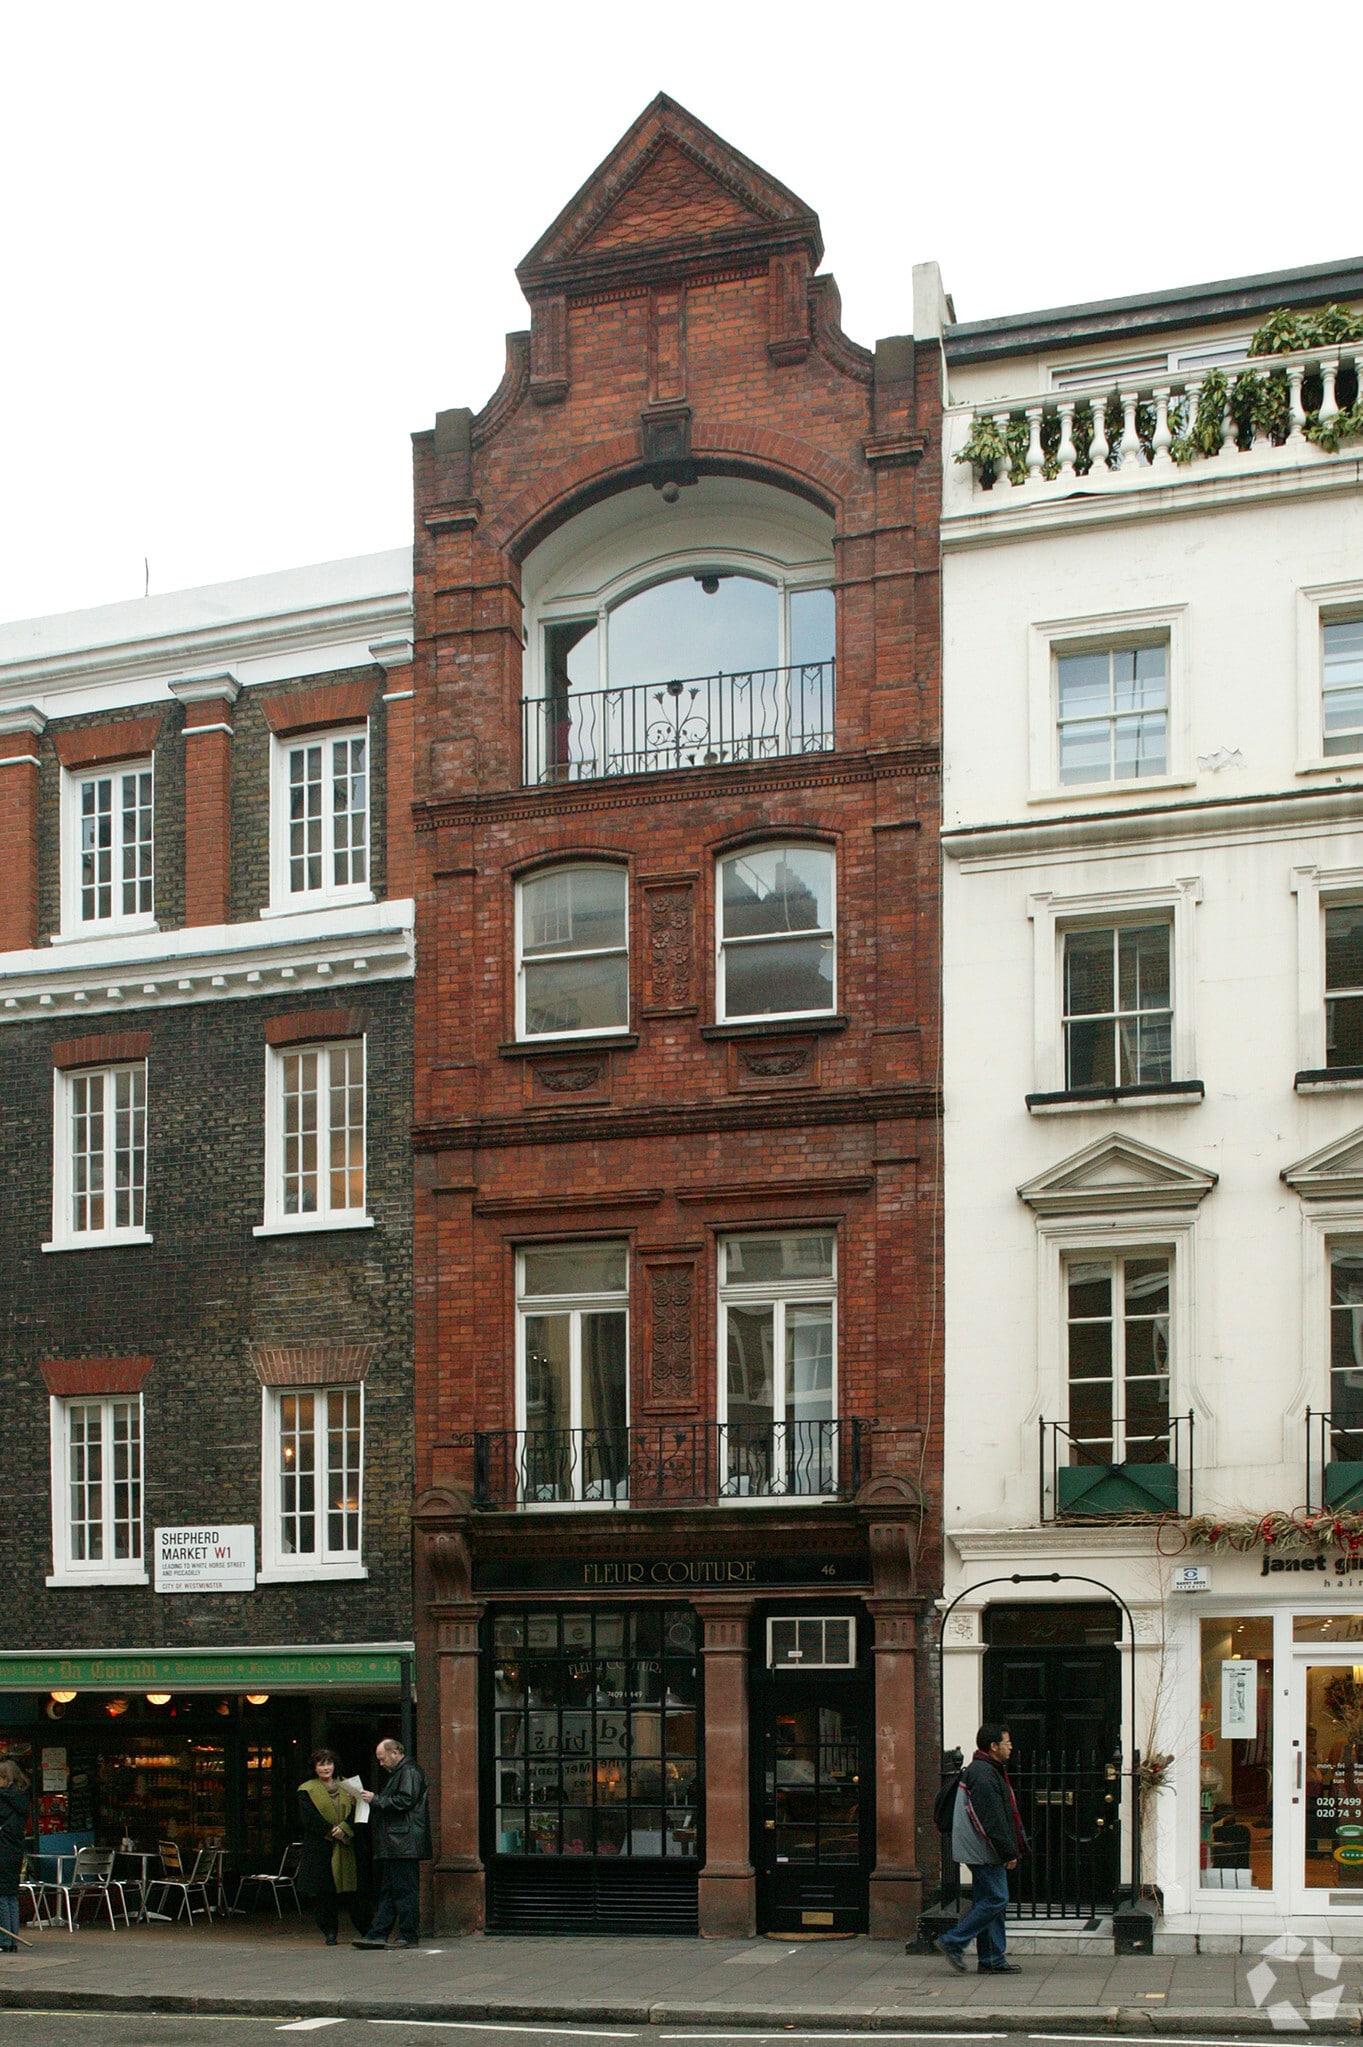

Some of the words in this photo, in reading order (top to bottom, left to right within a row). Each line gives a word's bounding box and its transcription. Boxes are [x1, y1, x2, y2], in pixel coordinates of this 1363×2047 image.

[162, 1532, 219, 1545] SHEPHERD
[162, 1547, 208, 1560] MARKET
[214, 1546, 231, 1558] W1
[821, 1564, 837, 1576] 46
[1261, 1554, 1327, 1577] janet
[584, 1563, 644, 1584] FLEUR
[651, 1561, 756, 1583] COUTURE
[59, 1661, 82, 1680] Da
[90, 1660, 157, 1680] Corradi
[175, 1663, 233, 1675] Restaurant
[279, 1661, 302, 1674] 0171
[307, 1661, 331, 1673] 409
[335, 1661, 363, 1673] 1962
[1316, 1797, 1335, 1806] 020
[1337, 1797, 1362, 1806] 7499
[1316, 1809, 1335, 1818] 020
